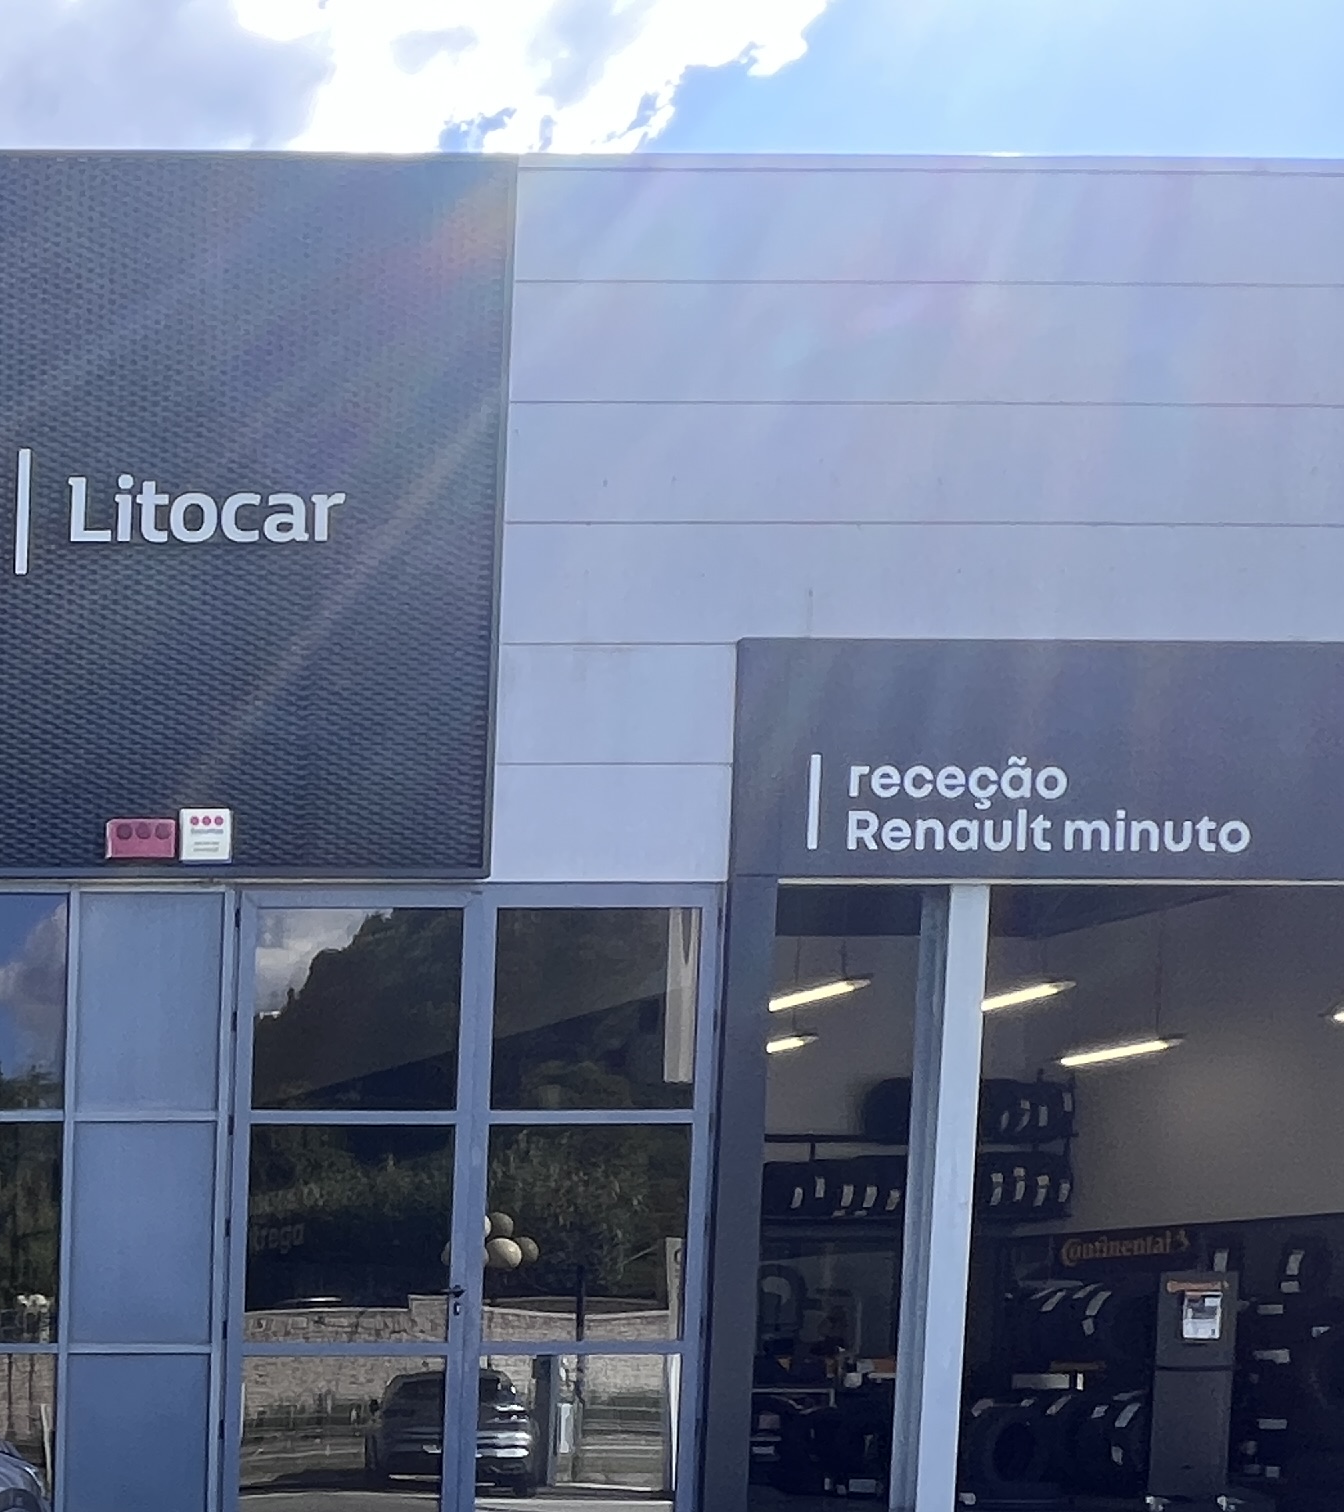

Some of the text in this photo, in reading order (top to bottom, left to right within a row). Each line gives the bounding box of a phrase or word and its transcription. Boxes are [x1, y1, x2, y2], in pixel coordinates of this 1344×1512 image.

[68, 473, 347, 543] Litocar
[847, 755, 1068, 809] receção
[846, 808, 1251, 853] Renault minuto
[1061, 1229, 1172, 1267] Continental
